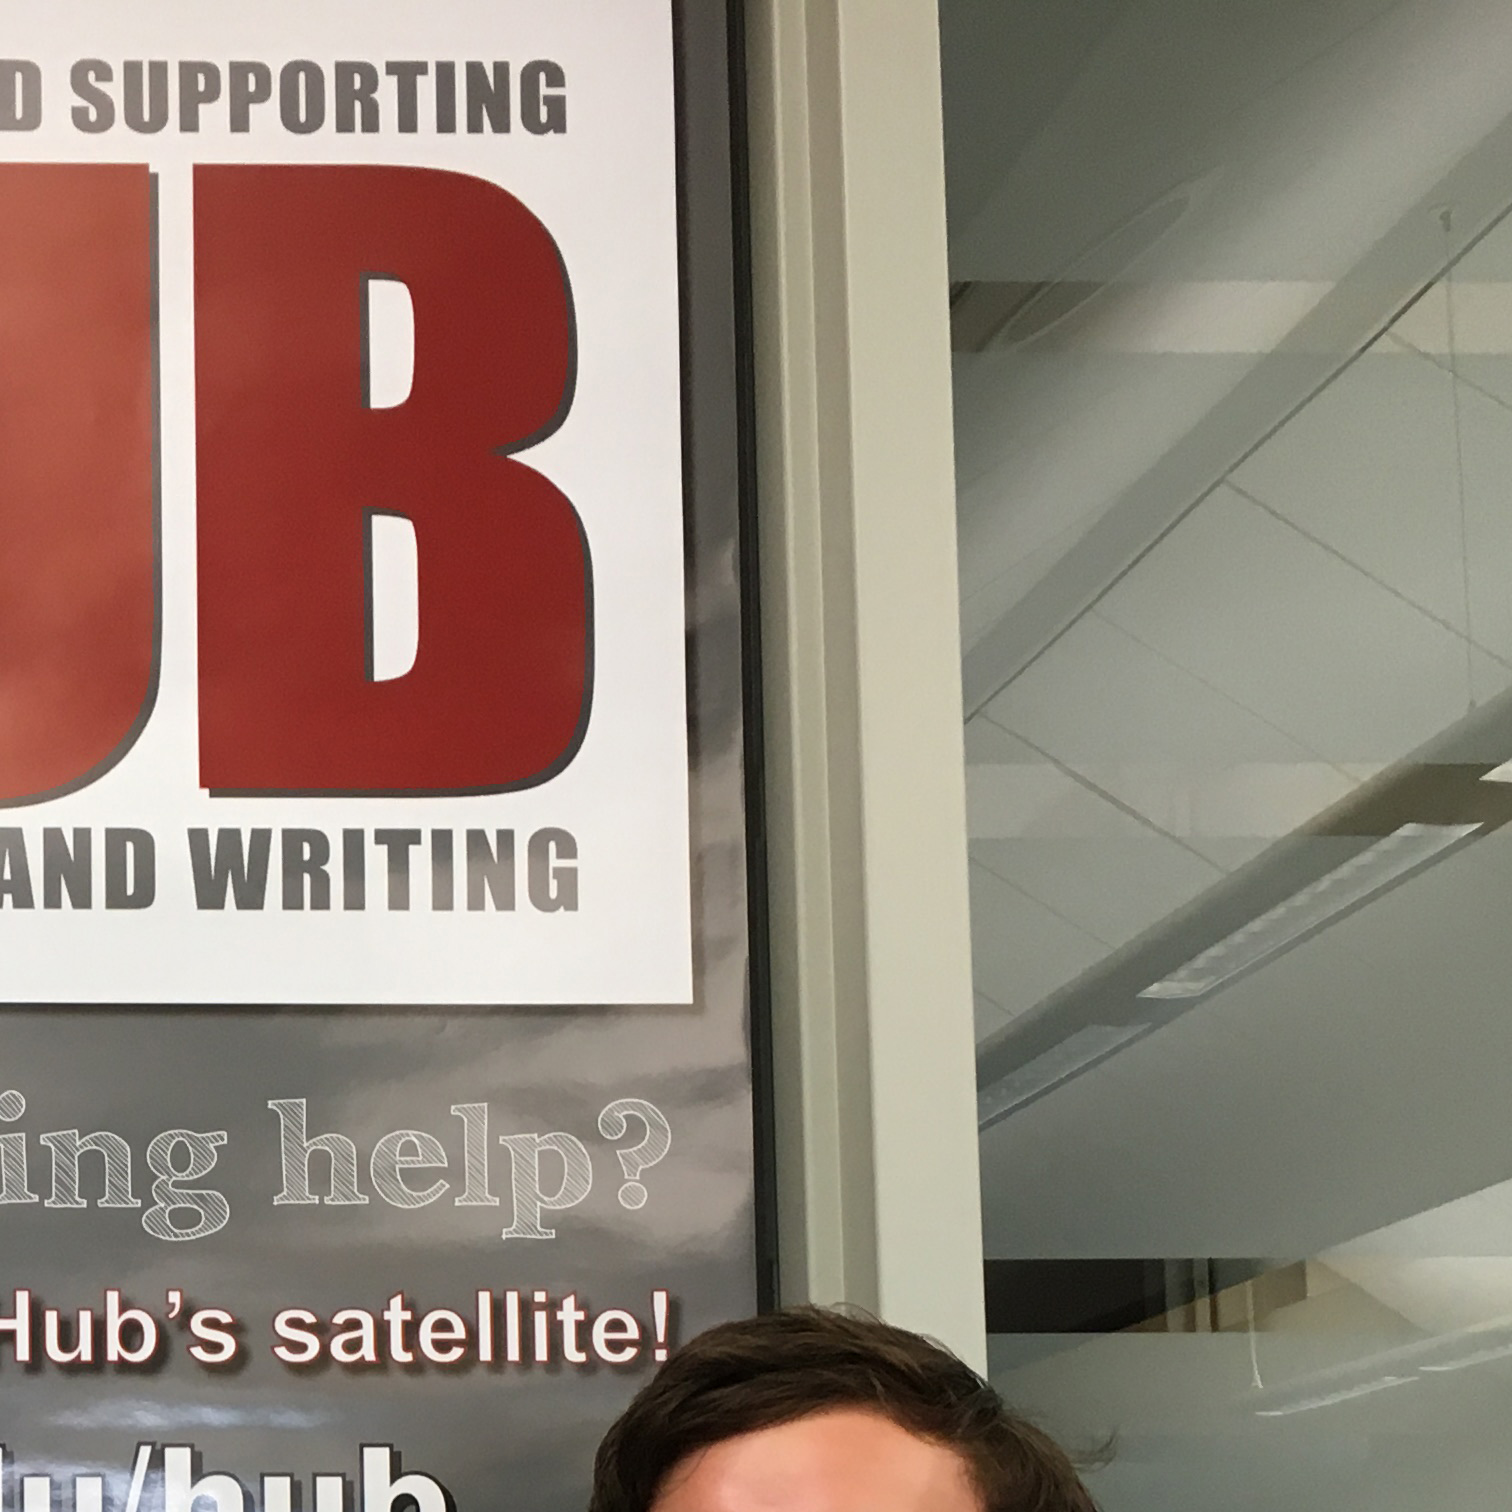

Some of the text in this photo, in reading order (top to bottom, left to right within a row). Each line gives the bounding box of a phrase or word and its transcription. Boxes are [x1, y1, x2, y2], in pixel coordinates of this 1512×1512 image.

[69, 58, 568, 136] SUPPORTING
[188, 826, 580, 914] WRITING
[267, 1097, 673, 1241] help?
[272, 1289, 673, 1366] satellite!
